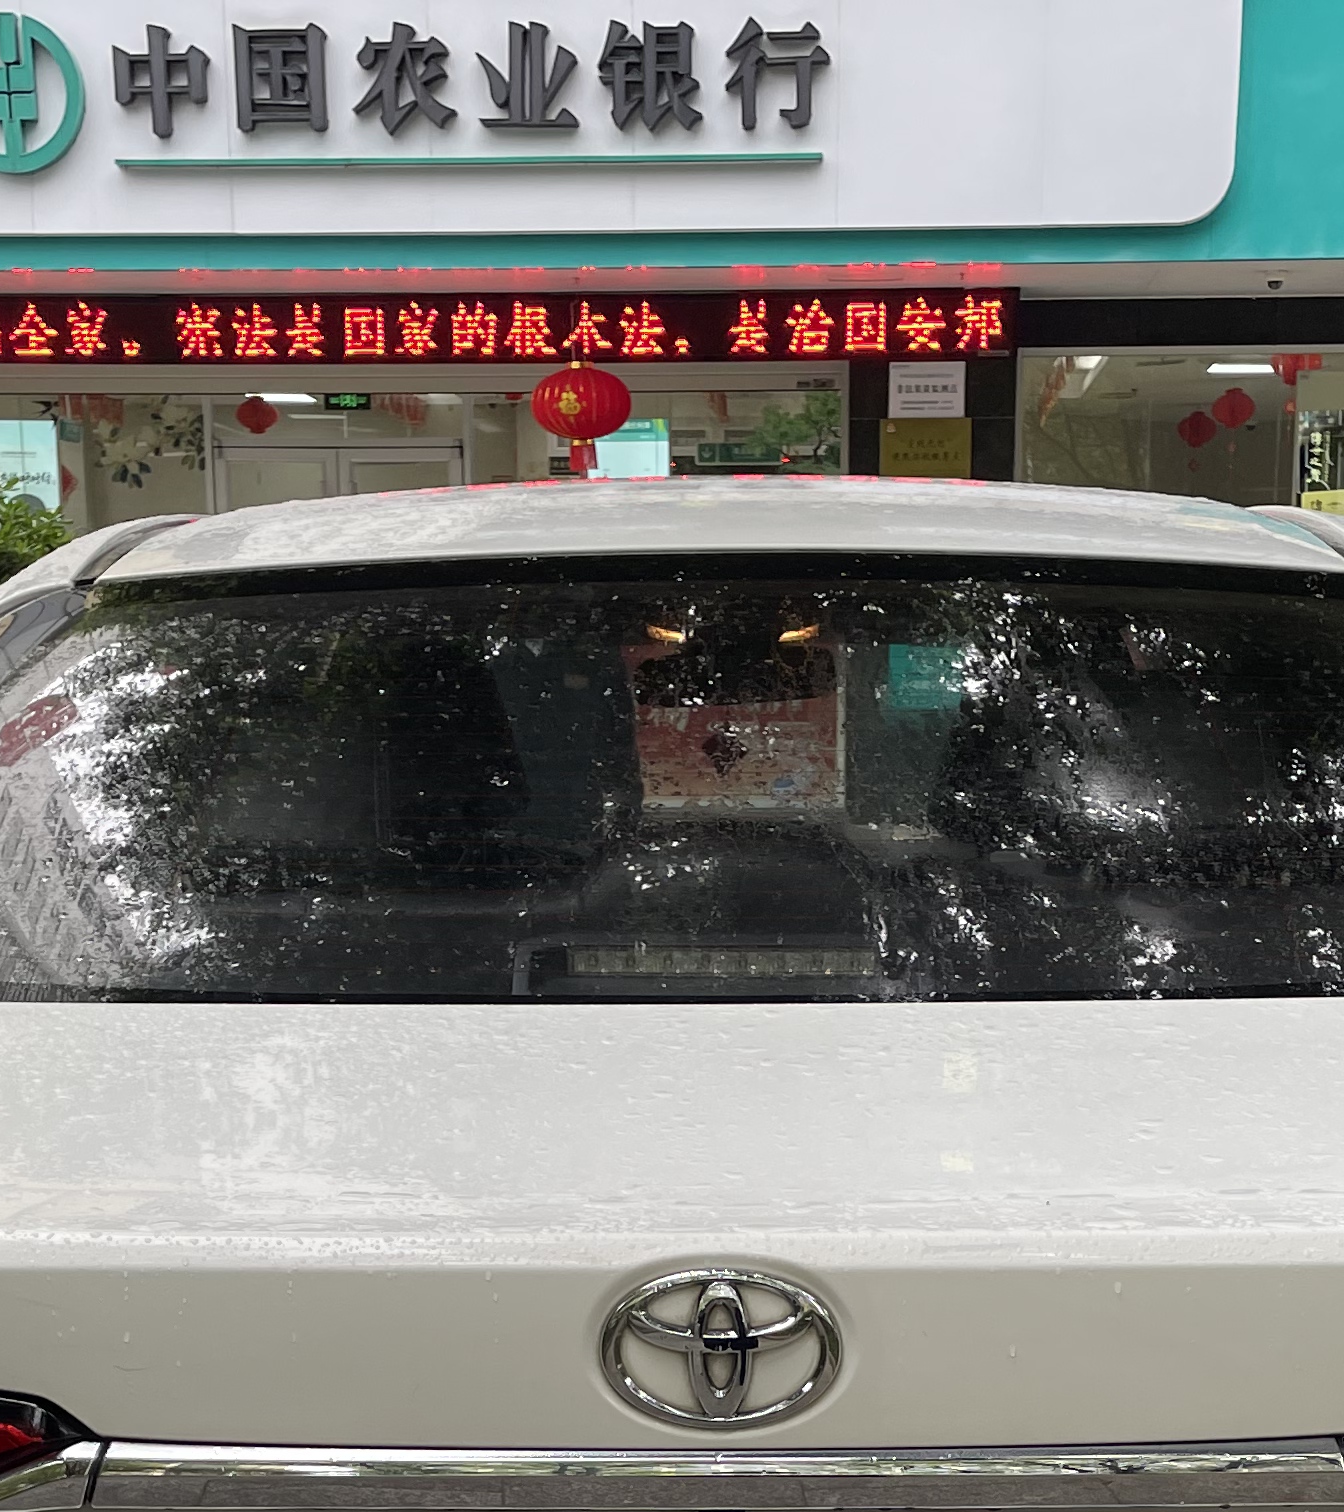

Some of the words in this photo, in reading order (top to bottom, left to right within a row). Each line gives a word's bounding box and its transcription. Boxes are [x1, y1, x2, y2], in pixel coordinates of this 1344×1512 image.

[112, 16, 832, 139] 中国农业银行
